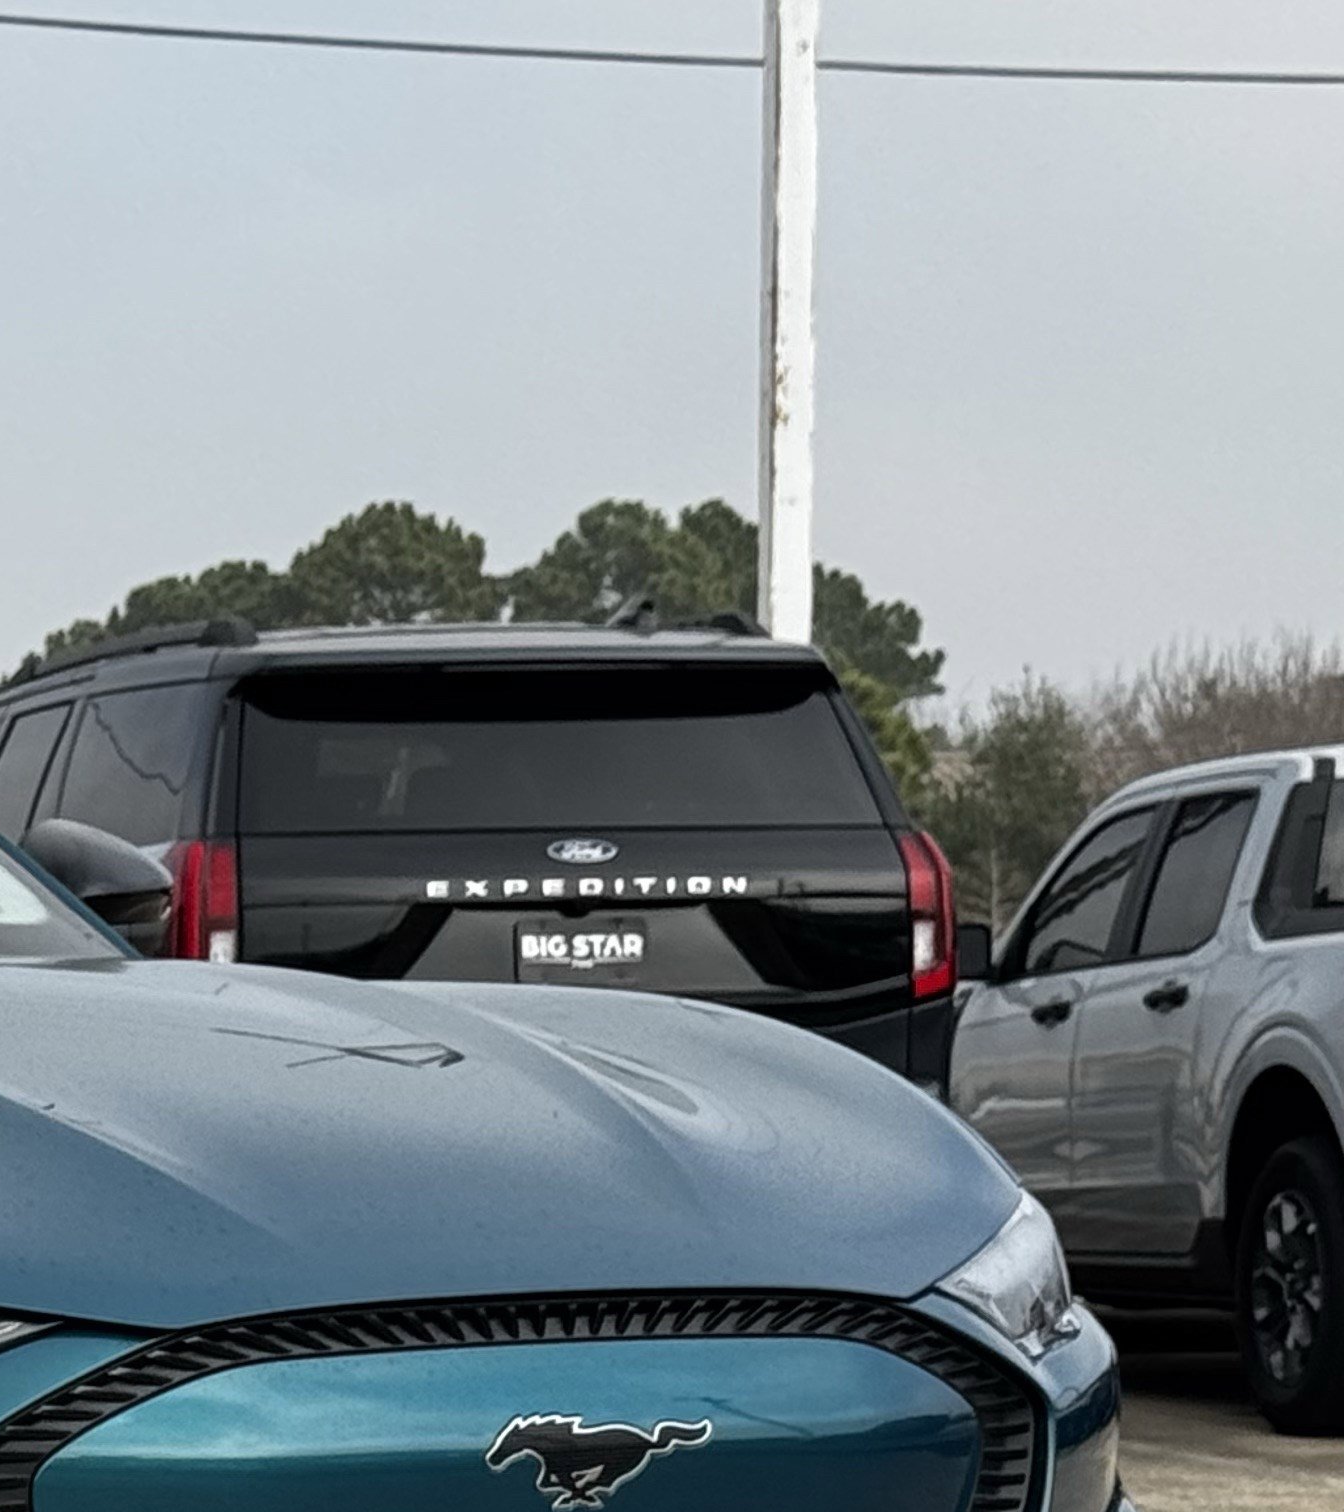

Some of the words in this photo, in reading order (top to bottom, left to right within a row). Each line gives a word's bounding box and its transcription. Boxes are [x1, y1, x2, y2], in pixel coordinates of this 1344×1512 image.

[425, 875, 747, 898] EXPEDITION
[521, 934, 568, 959] BIG
[572, 933, 644, 958] STAR
